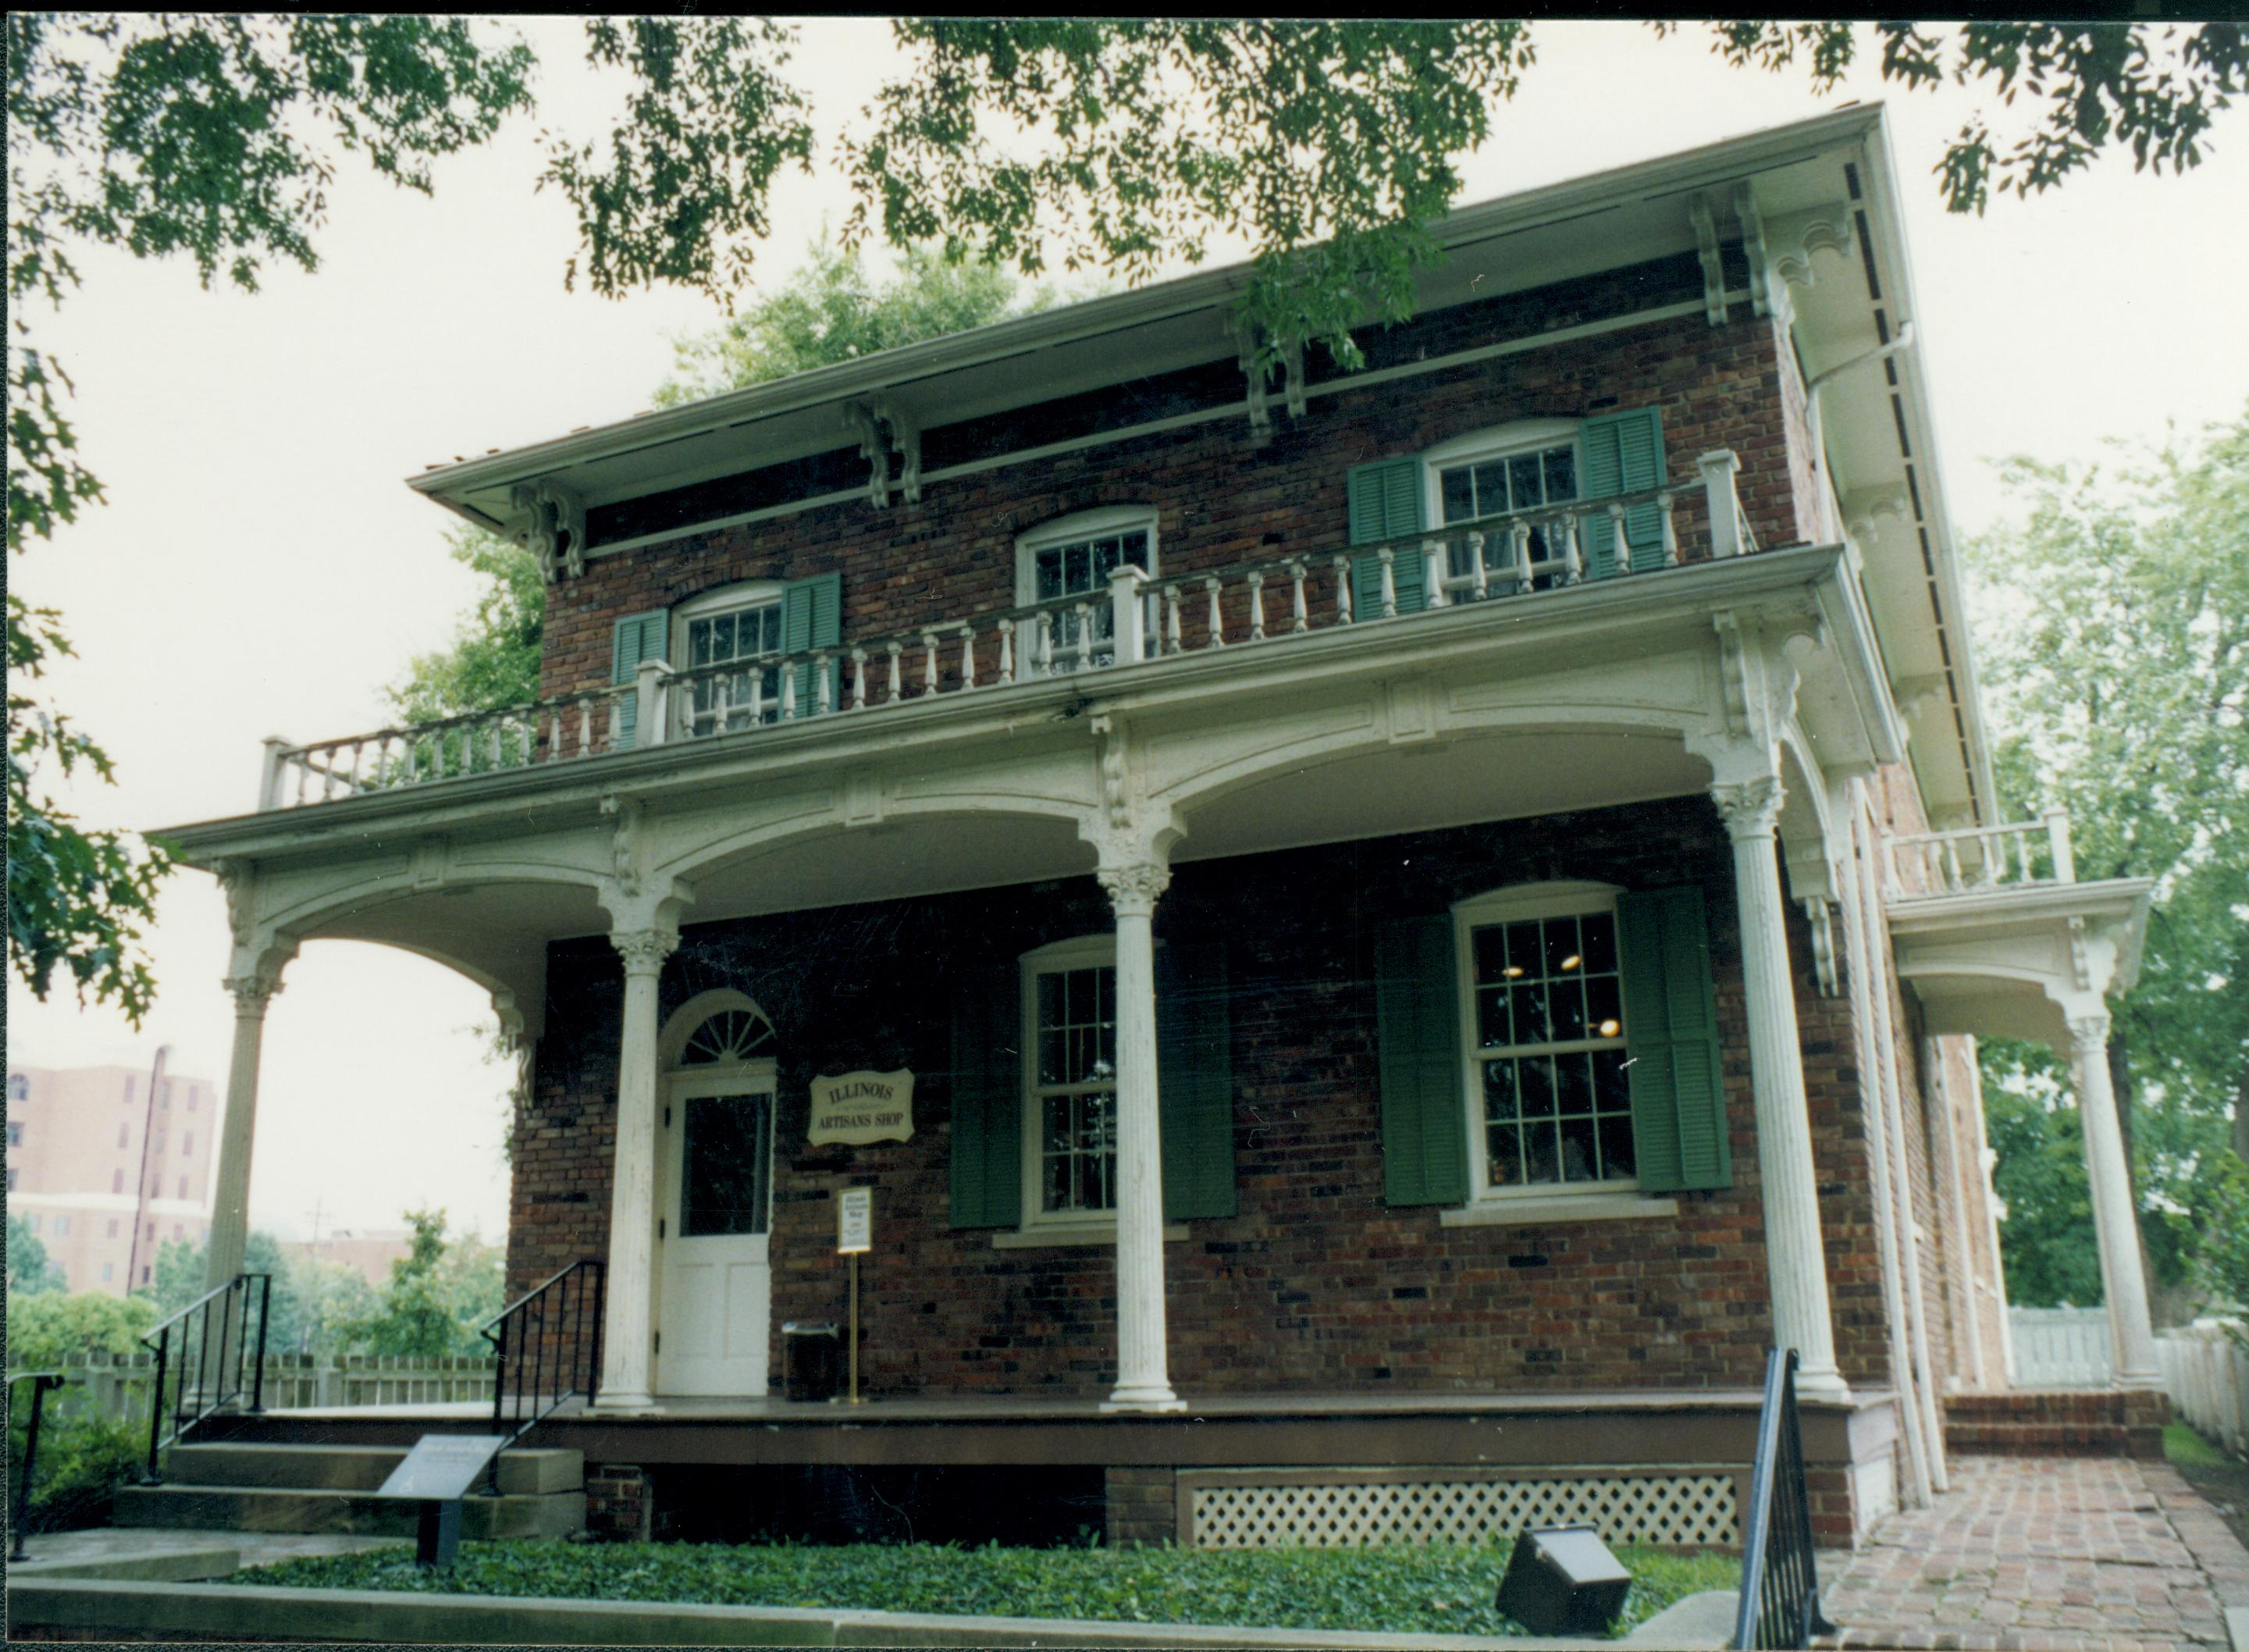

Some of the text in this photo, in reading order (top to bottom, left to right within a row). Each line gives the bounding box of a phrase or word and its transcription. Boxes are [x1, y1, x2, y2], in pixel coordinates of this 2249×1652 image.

[829, 1082, 893, 1104] ILLINOIS
[820, 1113, 903, 1130] ARTISANS SHOP
